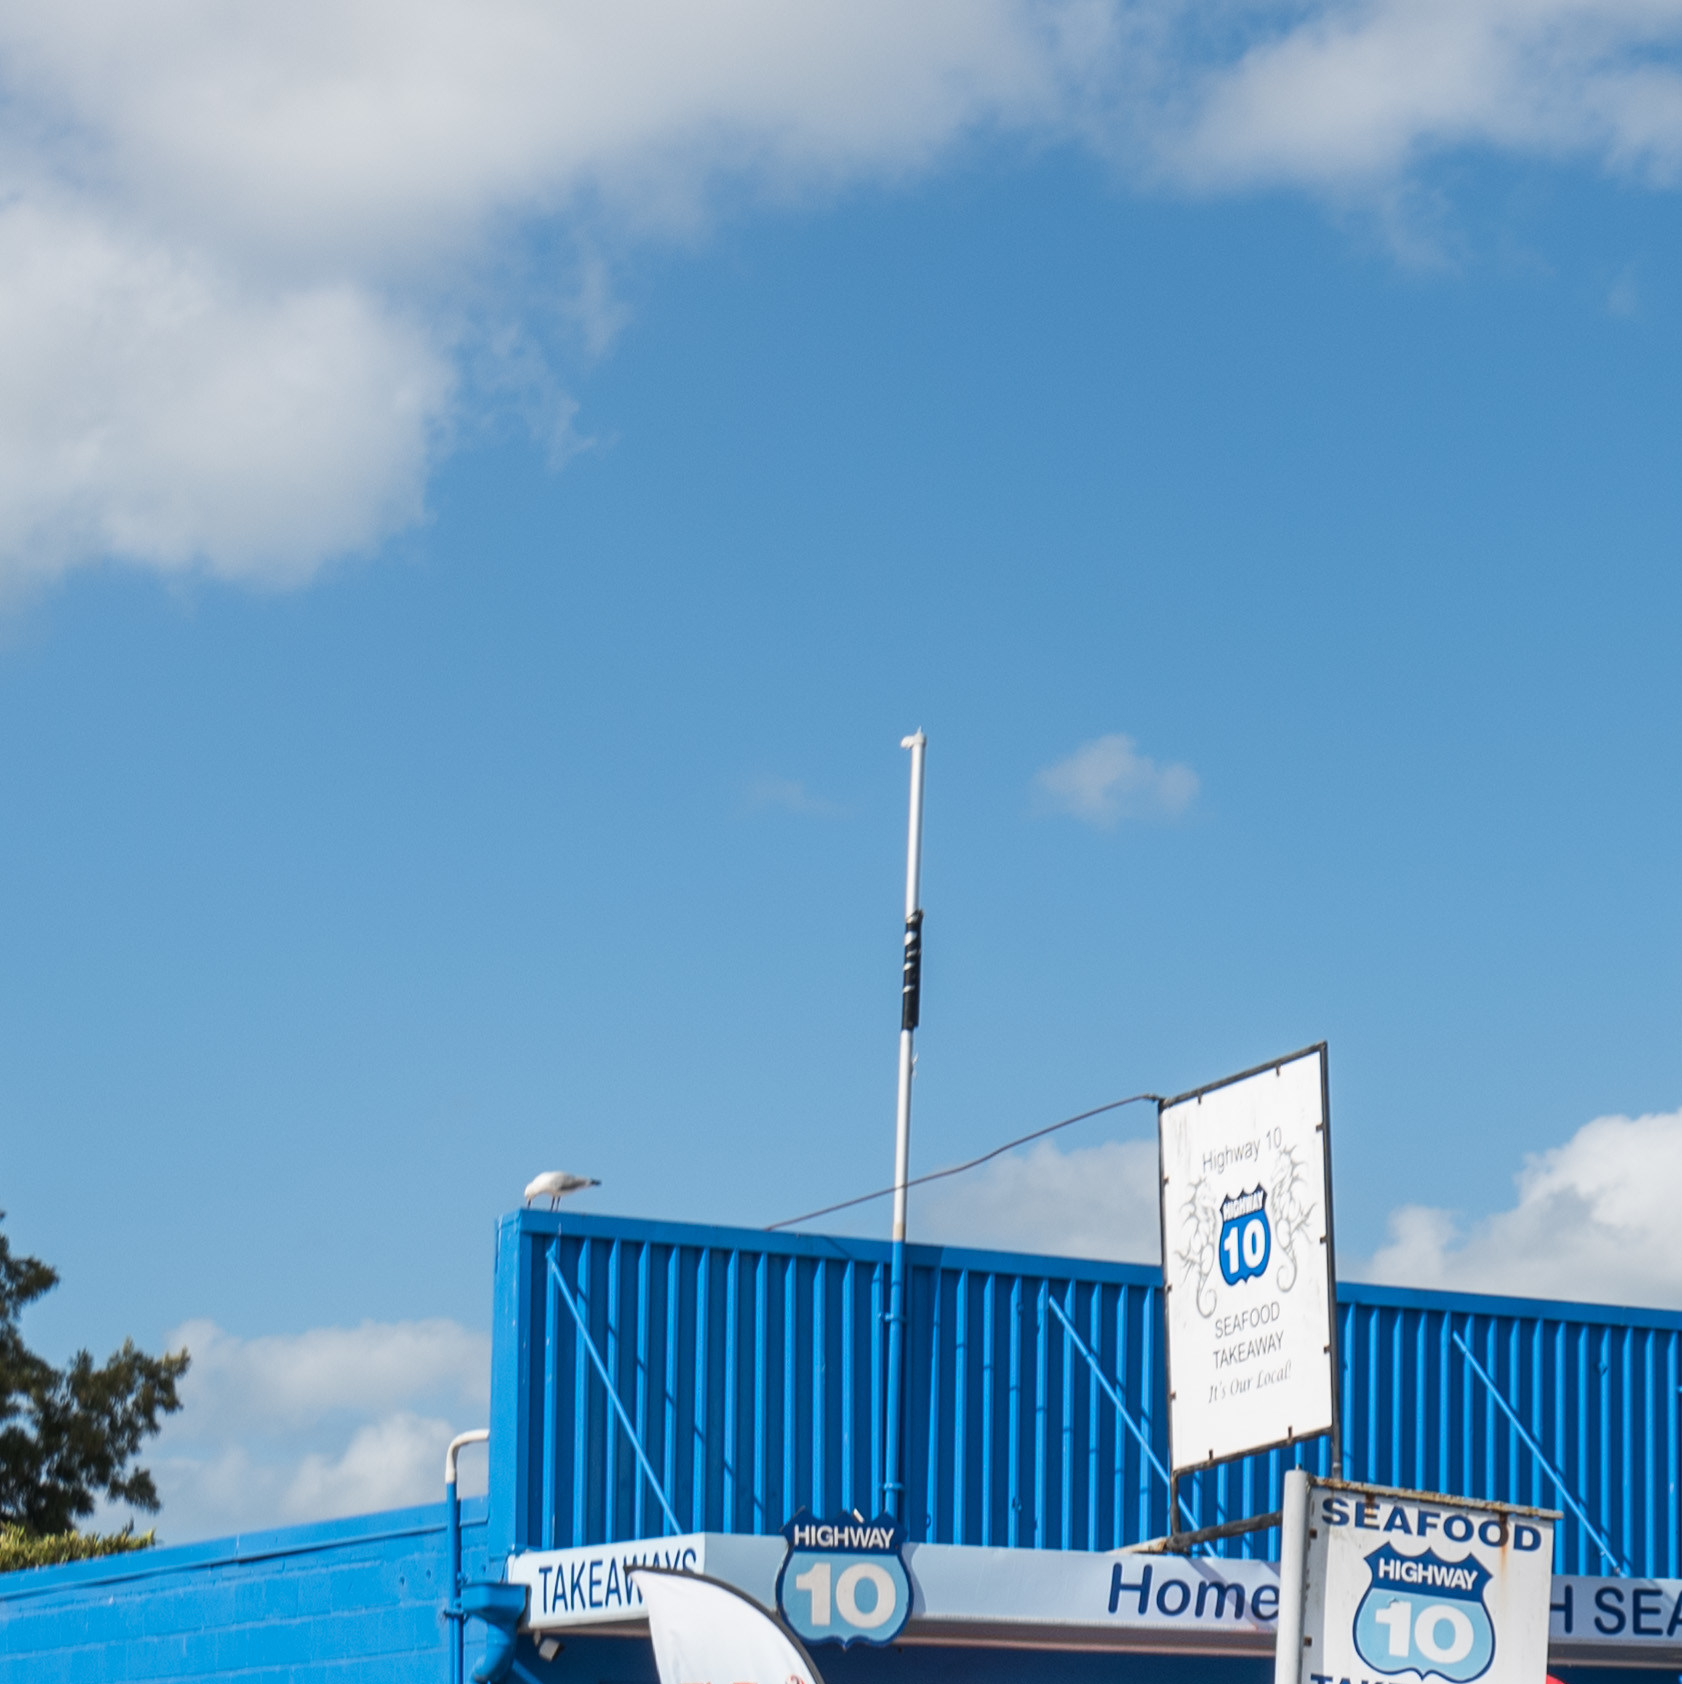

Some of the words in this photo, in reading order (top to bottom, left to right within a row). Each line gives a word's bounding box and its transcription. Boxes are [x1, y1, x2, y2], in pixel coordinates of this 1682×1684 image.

[1202, 1140, 1261, 1175] Highway
[1264, 1126, 1283, 1151] 10
[1223, 1188, 1265, 1222] HIGHWAY
[1223, 1217, 1268, 1275] 10
[1214, 1301, 1281, 1339] SEAFOOD
[1213, 1330, 1284, 1370] TAKEAWAY
[1208, 1383, 1230, 1404] It's
[1229, 1377, 1253, 1398] Our
[1256, 1362, 1292, 1391] Local!
[793, 1523, 895, 1550] HIGHWAY
[1320, 1496, 1542, 1552] SEAFOOD
[795, 1561, 898, 1630] 10
[1378, 1557, 1478, 1592] HIGHWAY
[1373, 1598, 1476, 1665] 10
